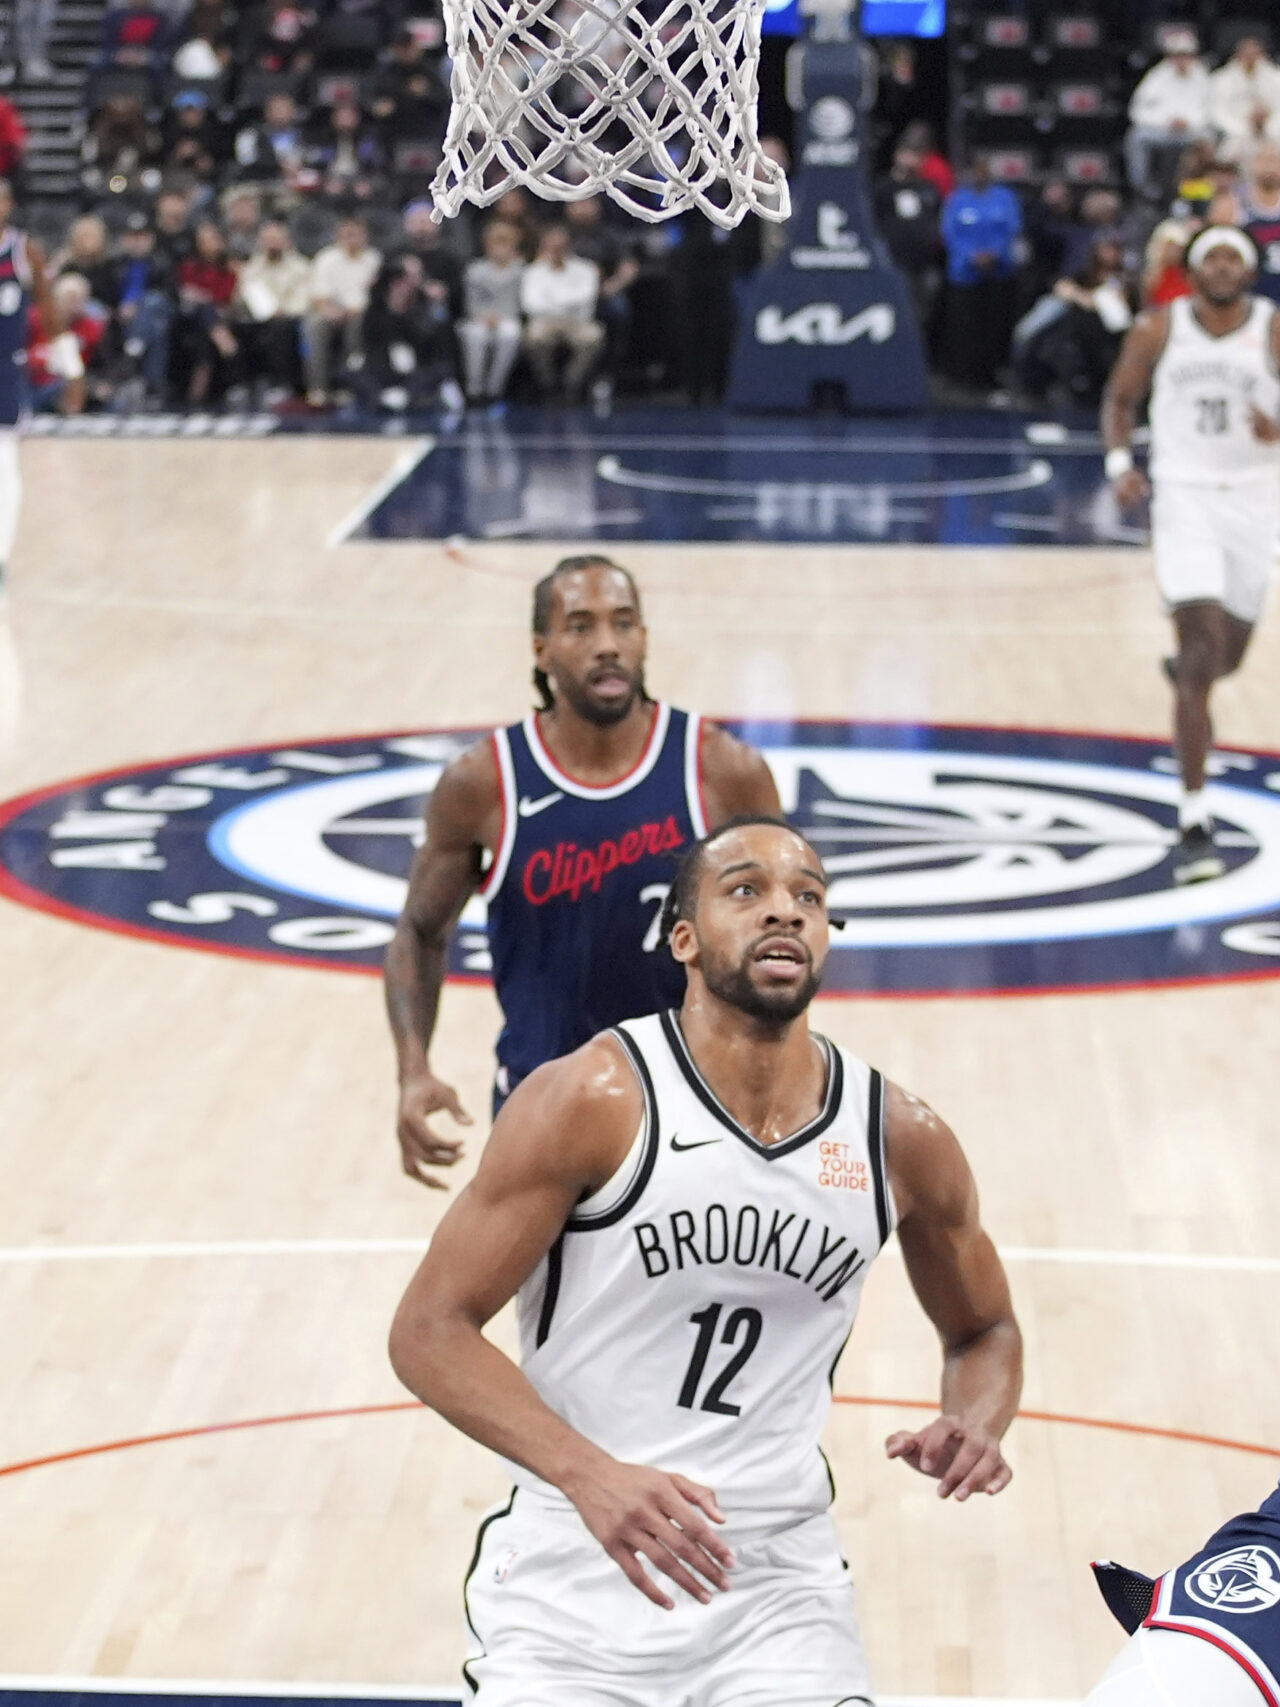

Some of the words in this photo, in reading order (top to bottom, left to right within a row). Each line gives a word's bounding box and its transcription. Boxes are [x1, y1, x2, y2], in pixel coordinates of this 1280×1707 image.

[523, 815, 684, 907] Clippers
[819, 1140, 850, 1158] GET
[820, 1156, 867, 1176] YOUR
[818, 1172, 869, 1192] GUIDE
[634, 1203, 865, 1302] BROOKLYN
[676, 1302, 763, 1417] 12
